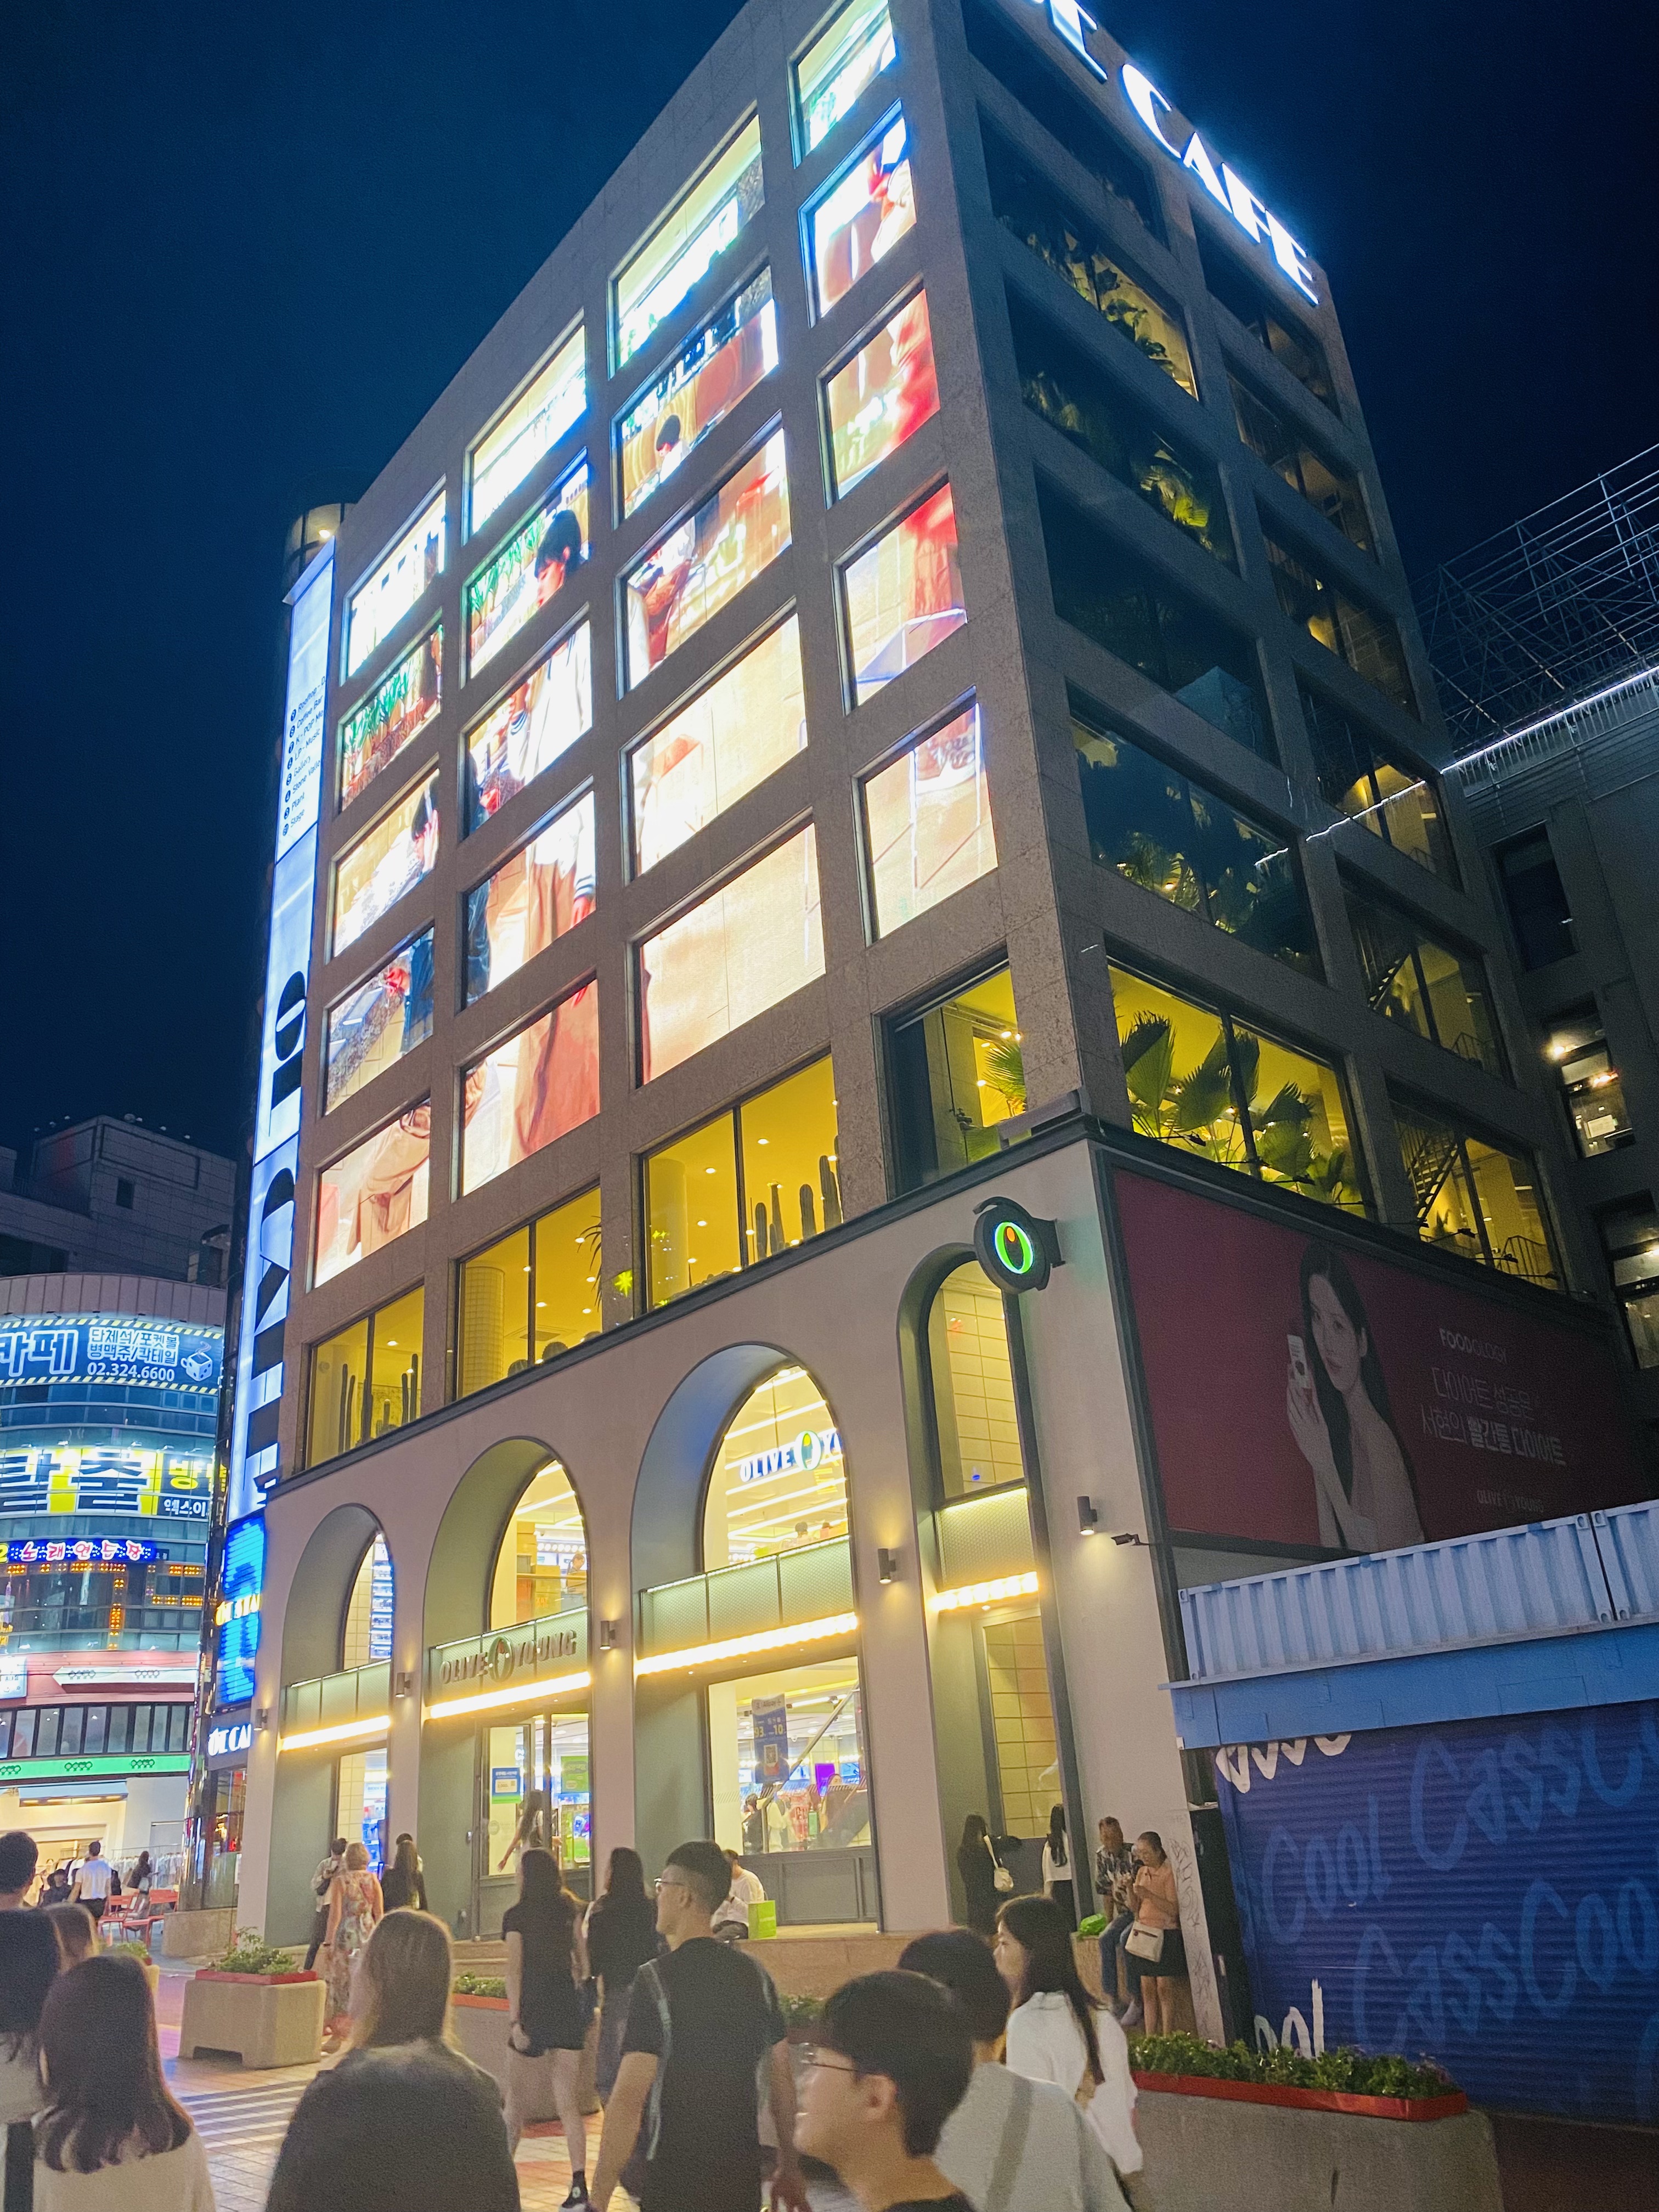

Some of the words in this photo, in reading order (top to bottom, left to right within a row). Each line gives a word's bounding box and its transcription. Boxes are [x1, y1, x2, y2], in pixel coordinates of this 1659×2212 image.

[1122, 64, 1319, 304] CAFE
[297, 708, 313, 729] Coffee
[314, 695, 323, 710] Bar
[298, 687, 317, 712] Rooftop
[294, 755, 311, 777] Gallery
[291, 792, 305, 811] Plant
[292, 775, 307, 794] Stone
[290, 809, 305, 827] Stage
[87, 1362, 175, 1381] 02.324.6600
[1431, 1367, 1493, 1410] 다이어트
[1421, 1404, 1468, 1444] 서현의
[1511, 1426, 1567, 1466] 다이어트
[739, 1445, 793, 1482] OLIVE
[1476, 1489, 1503, 1507] OLIVE
[440, 1651, 488, 1684] OLIVE
[514, 1629, 577, 1667] YOUNG
[773, 1724, 783, 1735] 10
[1410, 1724, 1581, 1870] Cass
[1262, 1793, 1392, 1945] Cool
[1353, 1921, 1521, 2055] Cass
